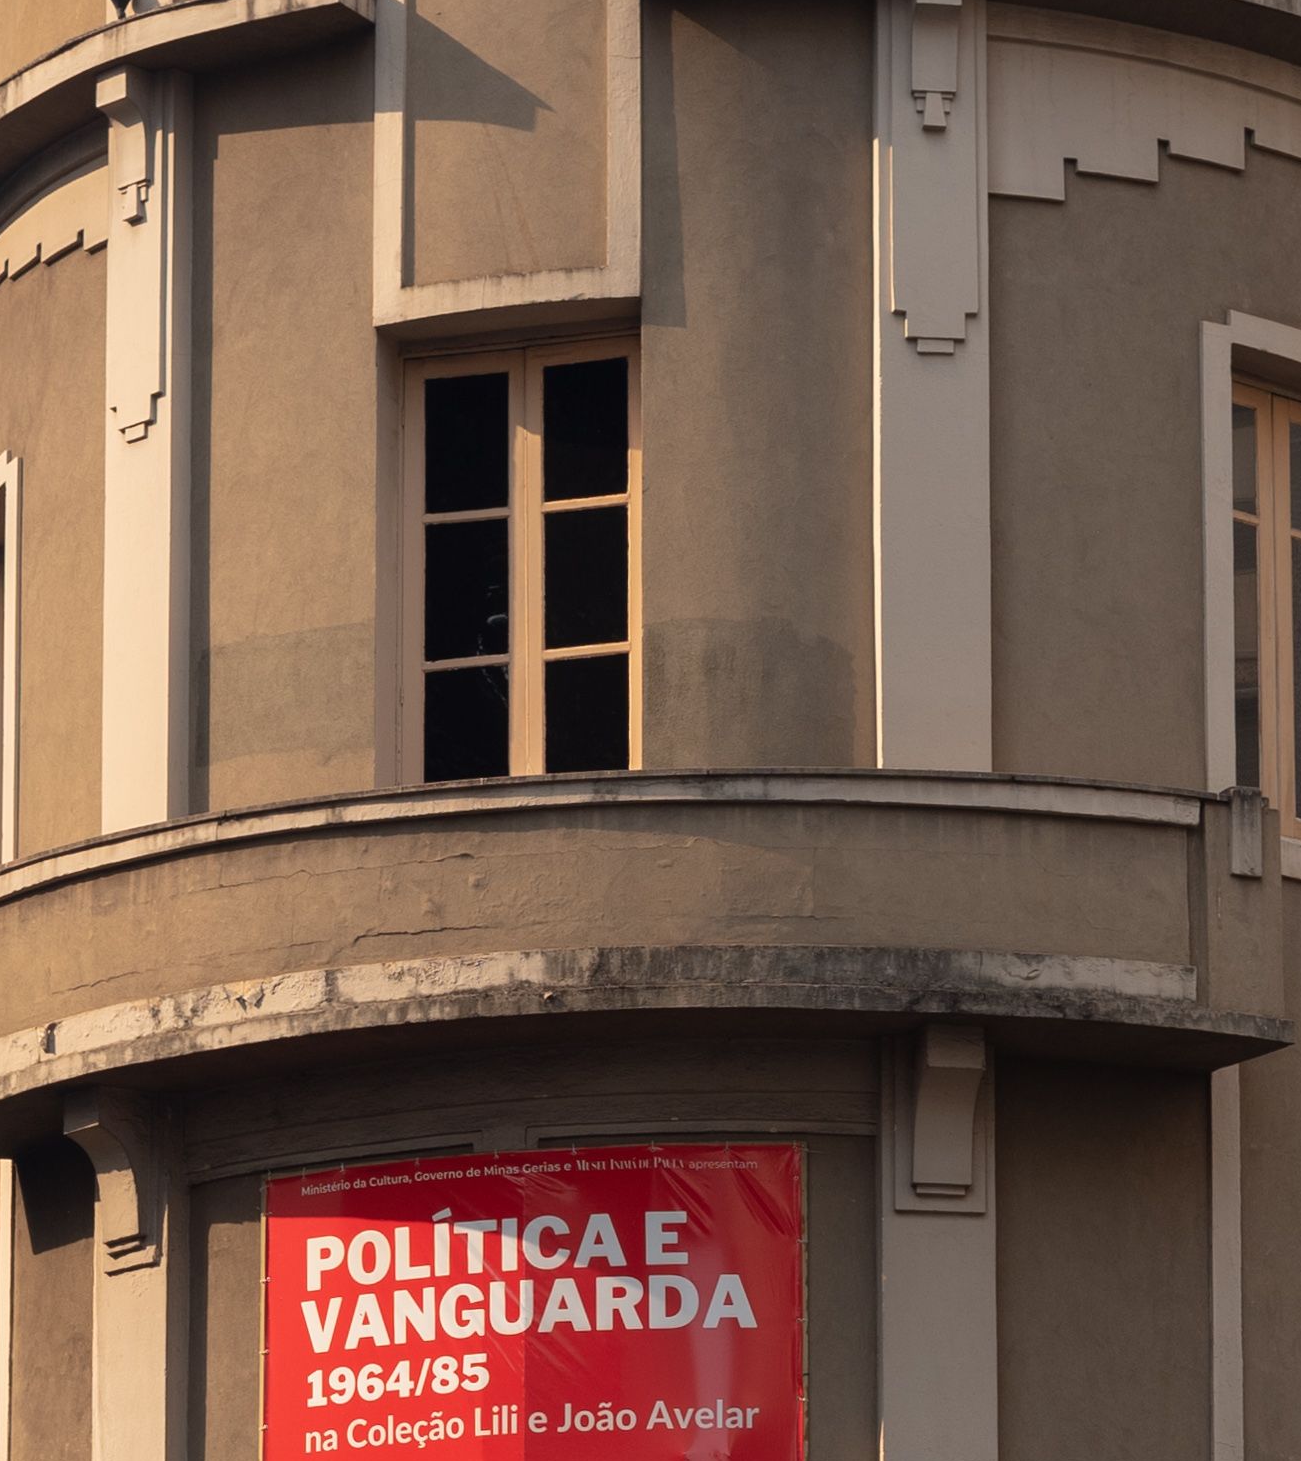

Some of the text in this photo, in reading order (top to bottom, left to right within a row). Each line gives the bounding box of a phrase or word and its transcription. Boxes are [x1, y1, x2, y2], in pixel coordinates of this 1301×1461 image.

[301, 1182, 351, 1196] Ministério
[353, 1179, 367, 1188] da
[369, 1174, 412, 1187] Cultura,
[415, 1170, 464, 1182] Governo
[466, 1167, 481, 1177] de
[484, 1164, 520, 1176] Minas
[564, 1162, 573, 1171] e
[689, 1159, 759, 1172] apresentam
[306, 1207, 689, 1291] POLÍTICA E
[301, 1274, 758, 1354] VANGUARDA
[306, 1353, 490, 1408] 1964/85
[305, 1399, 759, 1453] na Coleção Lili e João Avelar
